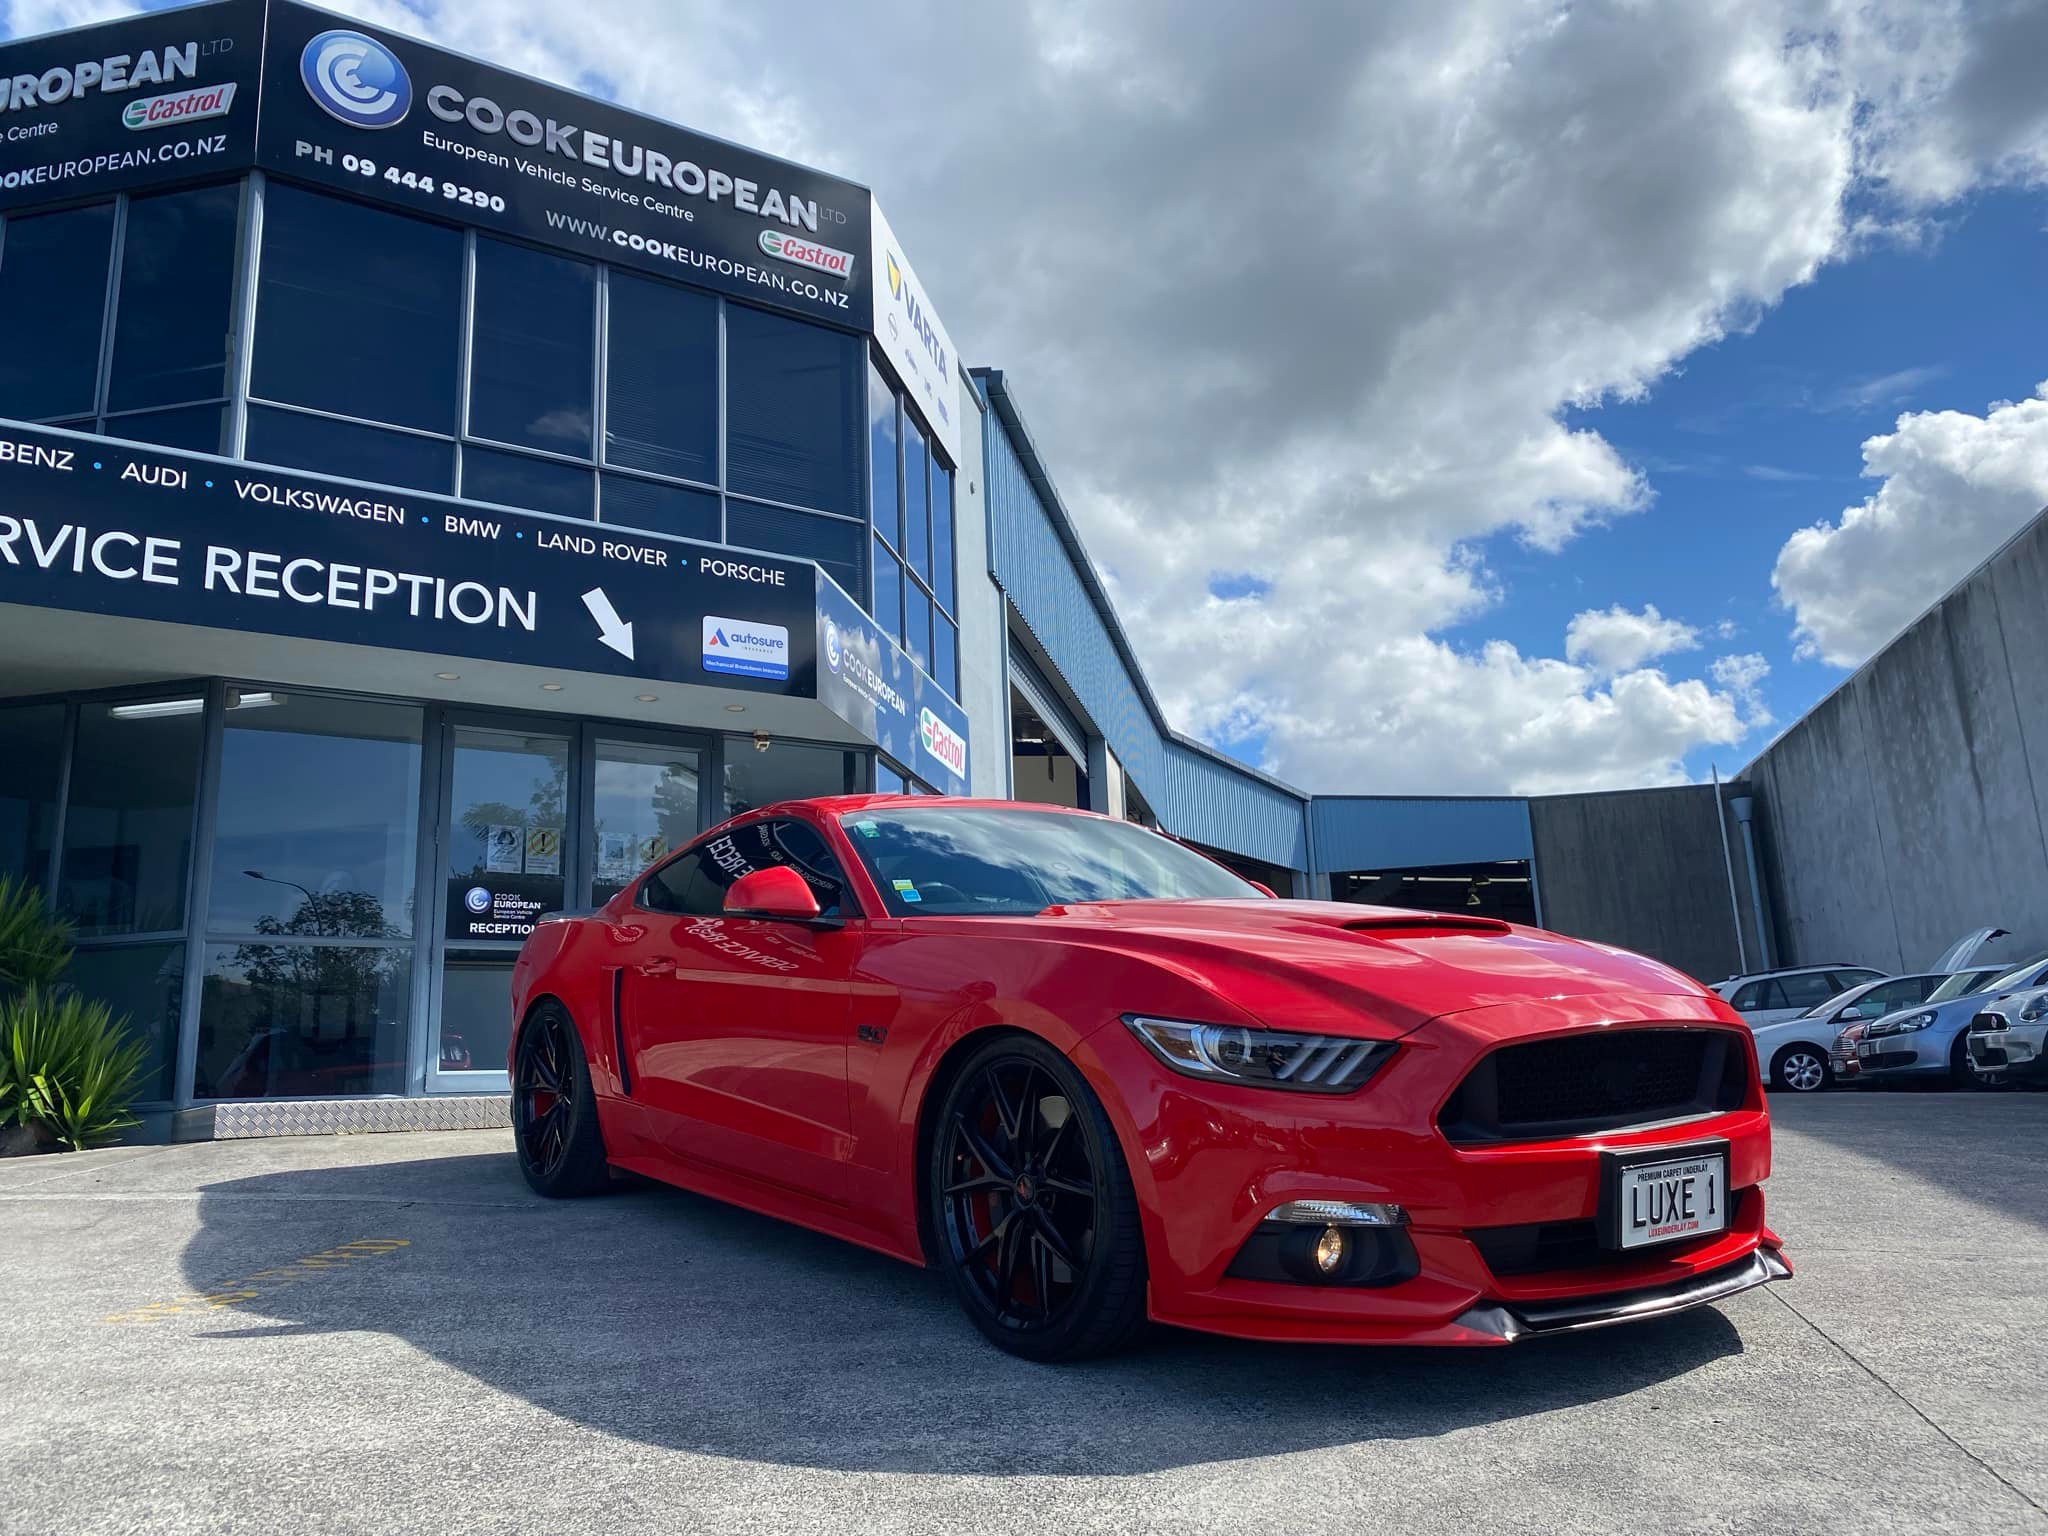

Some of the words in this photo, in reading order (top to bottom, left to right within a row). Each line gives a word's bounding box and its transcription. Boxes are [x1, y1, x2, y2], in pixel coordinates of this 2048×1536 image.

[202, 38, 233, 56] LTD
[148, 88, 225, 121] Castrol
[7, 122, 58, 141] Centre
[0, 134, 226, 189] OKEUROPEAN.CO.NZ
[295, 140, 333, 166] PH
[341, 153, 377, 177] 09
[383, 165, 435, 194] 444
[441, 181, 506, 213] 9290
[423, 130, 510, 169] European
[514, 158, 577, 188] Vehicle
[581, 177, 639, 207] Service
[643, 194, 694, 222] Centre
[819, 206, 847, 225] LTD
[545, 209, 849, 309] WWW.COOKEUROPEAN.CO.NZ
[782, 237, 847, 273] Castrol
[903, 279, 949, 385] VARTA
[0, 440, 75, 471] BENZ
[120, 461, 187, 489] AUDI
[233, 479, 405, 525] VOLKSWAGEN
[444, 514, 501, 540] BMW
[537, 530, 596, 555] LAND
[602, 541, 668, 567] ROVER
[700, 558, 786, 587] PORSCHE
[204, 545, 536, 632] RECEPTION
[731, 633, 784, 648] autosure
[931, 720, 964, 772] Castrol
[493, 901, 542, 909] EUROPEAN
[494, 893, 521, 901] COOK
[1637, 1170, 1662, 1182] PREMIUM
[1662, 1167, 1682, 1179] CARPET
[1683, 1162, 1708, 1176] UNDERLAY
[1632, 1175, 1696, 1229] LUXE
[1708, 1172, 1716, 1215] 1
